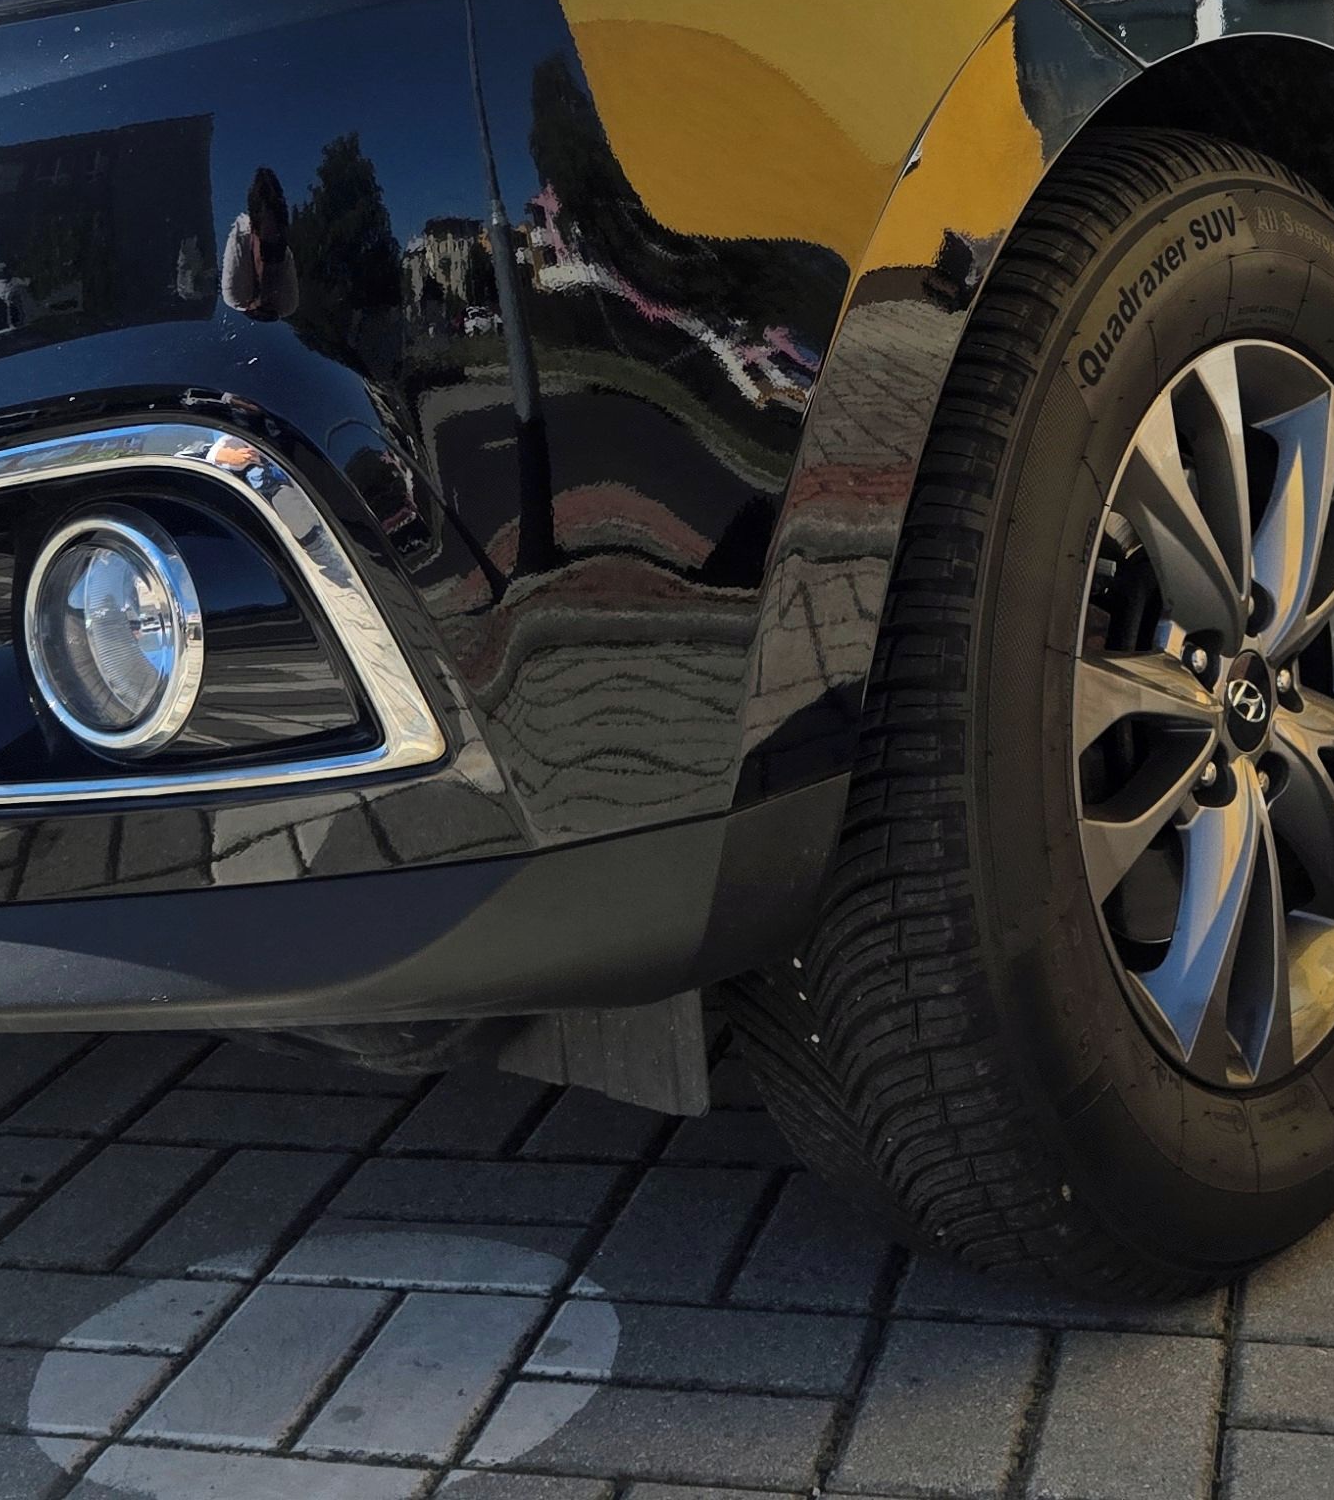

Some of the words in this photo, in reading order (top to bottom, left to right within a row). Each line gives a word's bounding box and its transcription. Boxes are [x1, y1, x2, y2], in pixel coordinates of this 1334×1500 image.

[1256, 206, 1279, 233] All
[1078, 234, 1187, 387] Quadraxer
[1189, 206, 1236, 250] SUV
